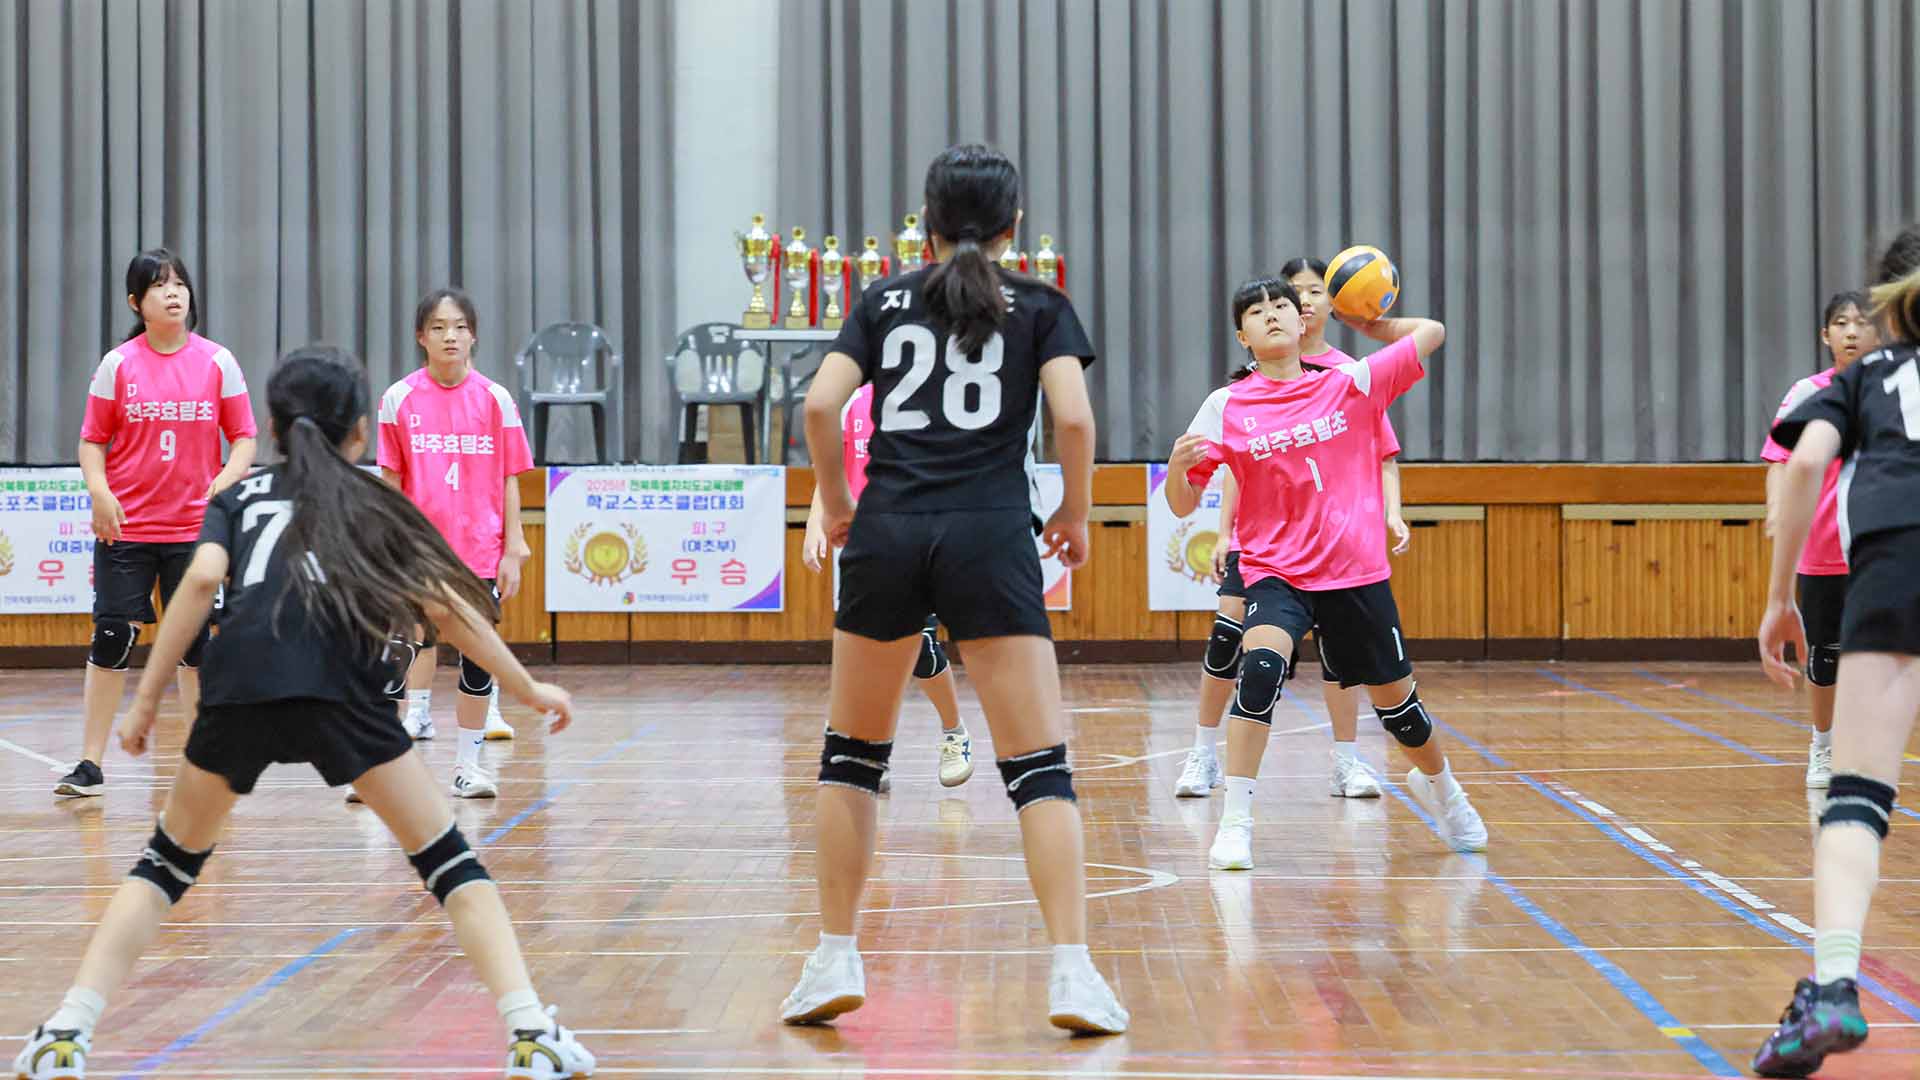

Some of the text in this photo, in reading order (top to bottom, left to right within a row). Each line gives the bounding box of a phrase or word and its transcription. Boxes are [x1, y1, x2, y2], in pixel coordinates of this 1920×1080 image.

[880, 324, 1004, 432] 28
[124, 400, 214, 423] 전주효림초
[159, 429, 176, 461] 9
[410, 433, 495, 455] 전주효림초
[1247, 410, 1348, 462] 전주효림초
[444, 462, 460, 491] 4
[1305, 456, 1323, 492] 1
[0, 495, 93, 511] 포츠클럽대
[586, 494, 744, 510] 학교스포츠클럽대회
[242, 500, 326, 587] 7
